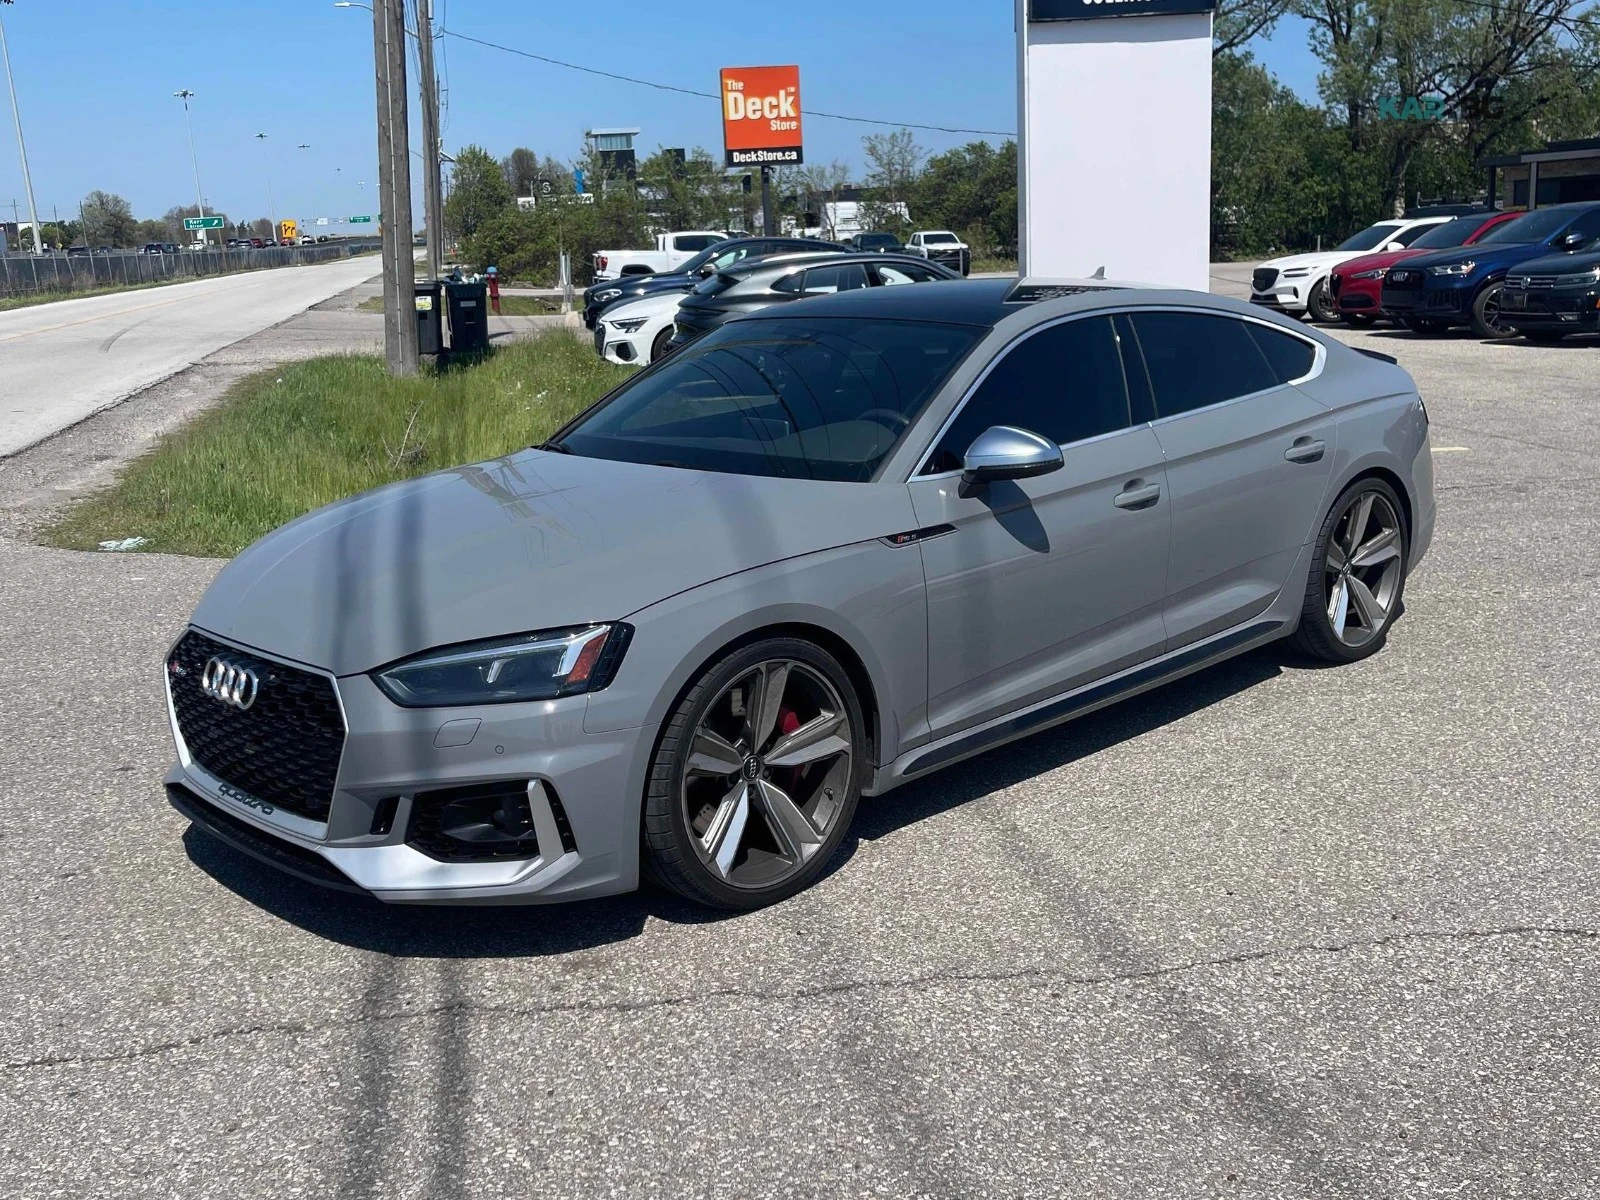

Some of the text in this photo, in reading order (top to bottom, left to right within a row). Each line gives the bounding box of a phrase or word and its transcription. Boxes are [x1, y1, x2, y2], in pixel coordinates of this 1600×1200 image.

[727, 80, 744, 90] The
[727, 89, 796, 121] Deck
[770, 119, 797, 131] Store
[733, 151, 798, 163] DeckStore.ca
[218, 783, 275, 816] quattro
